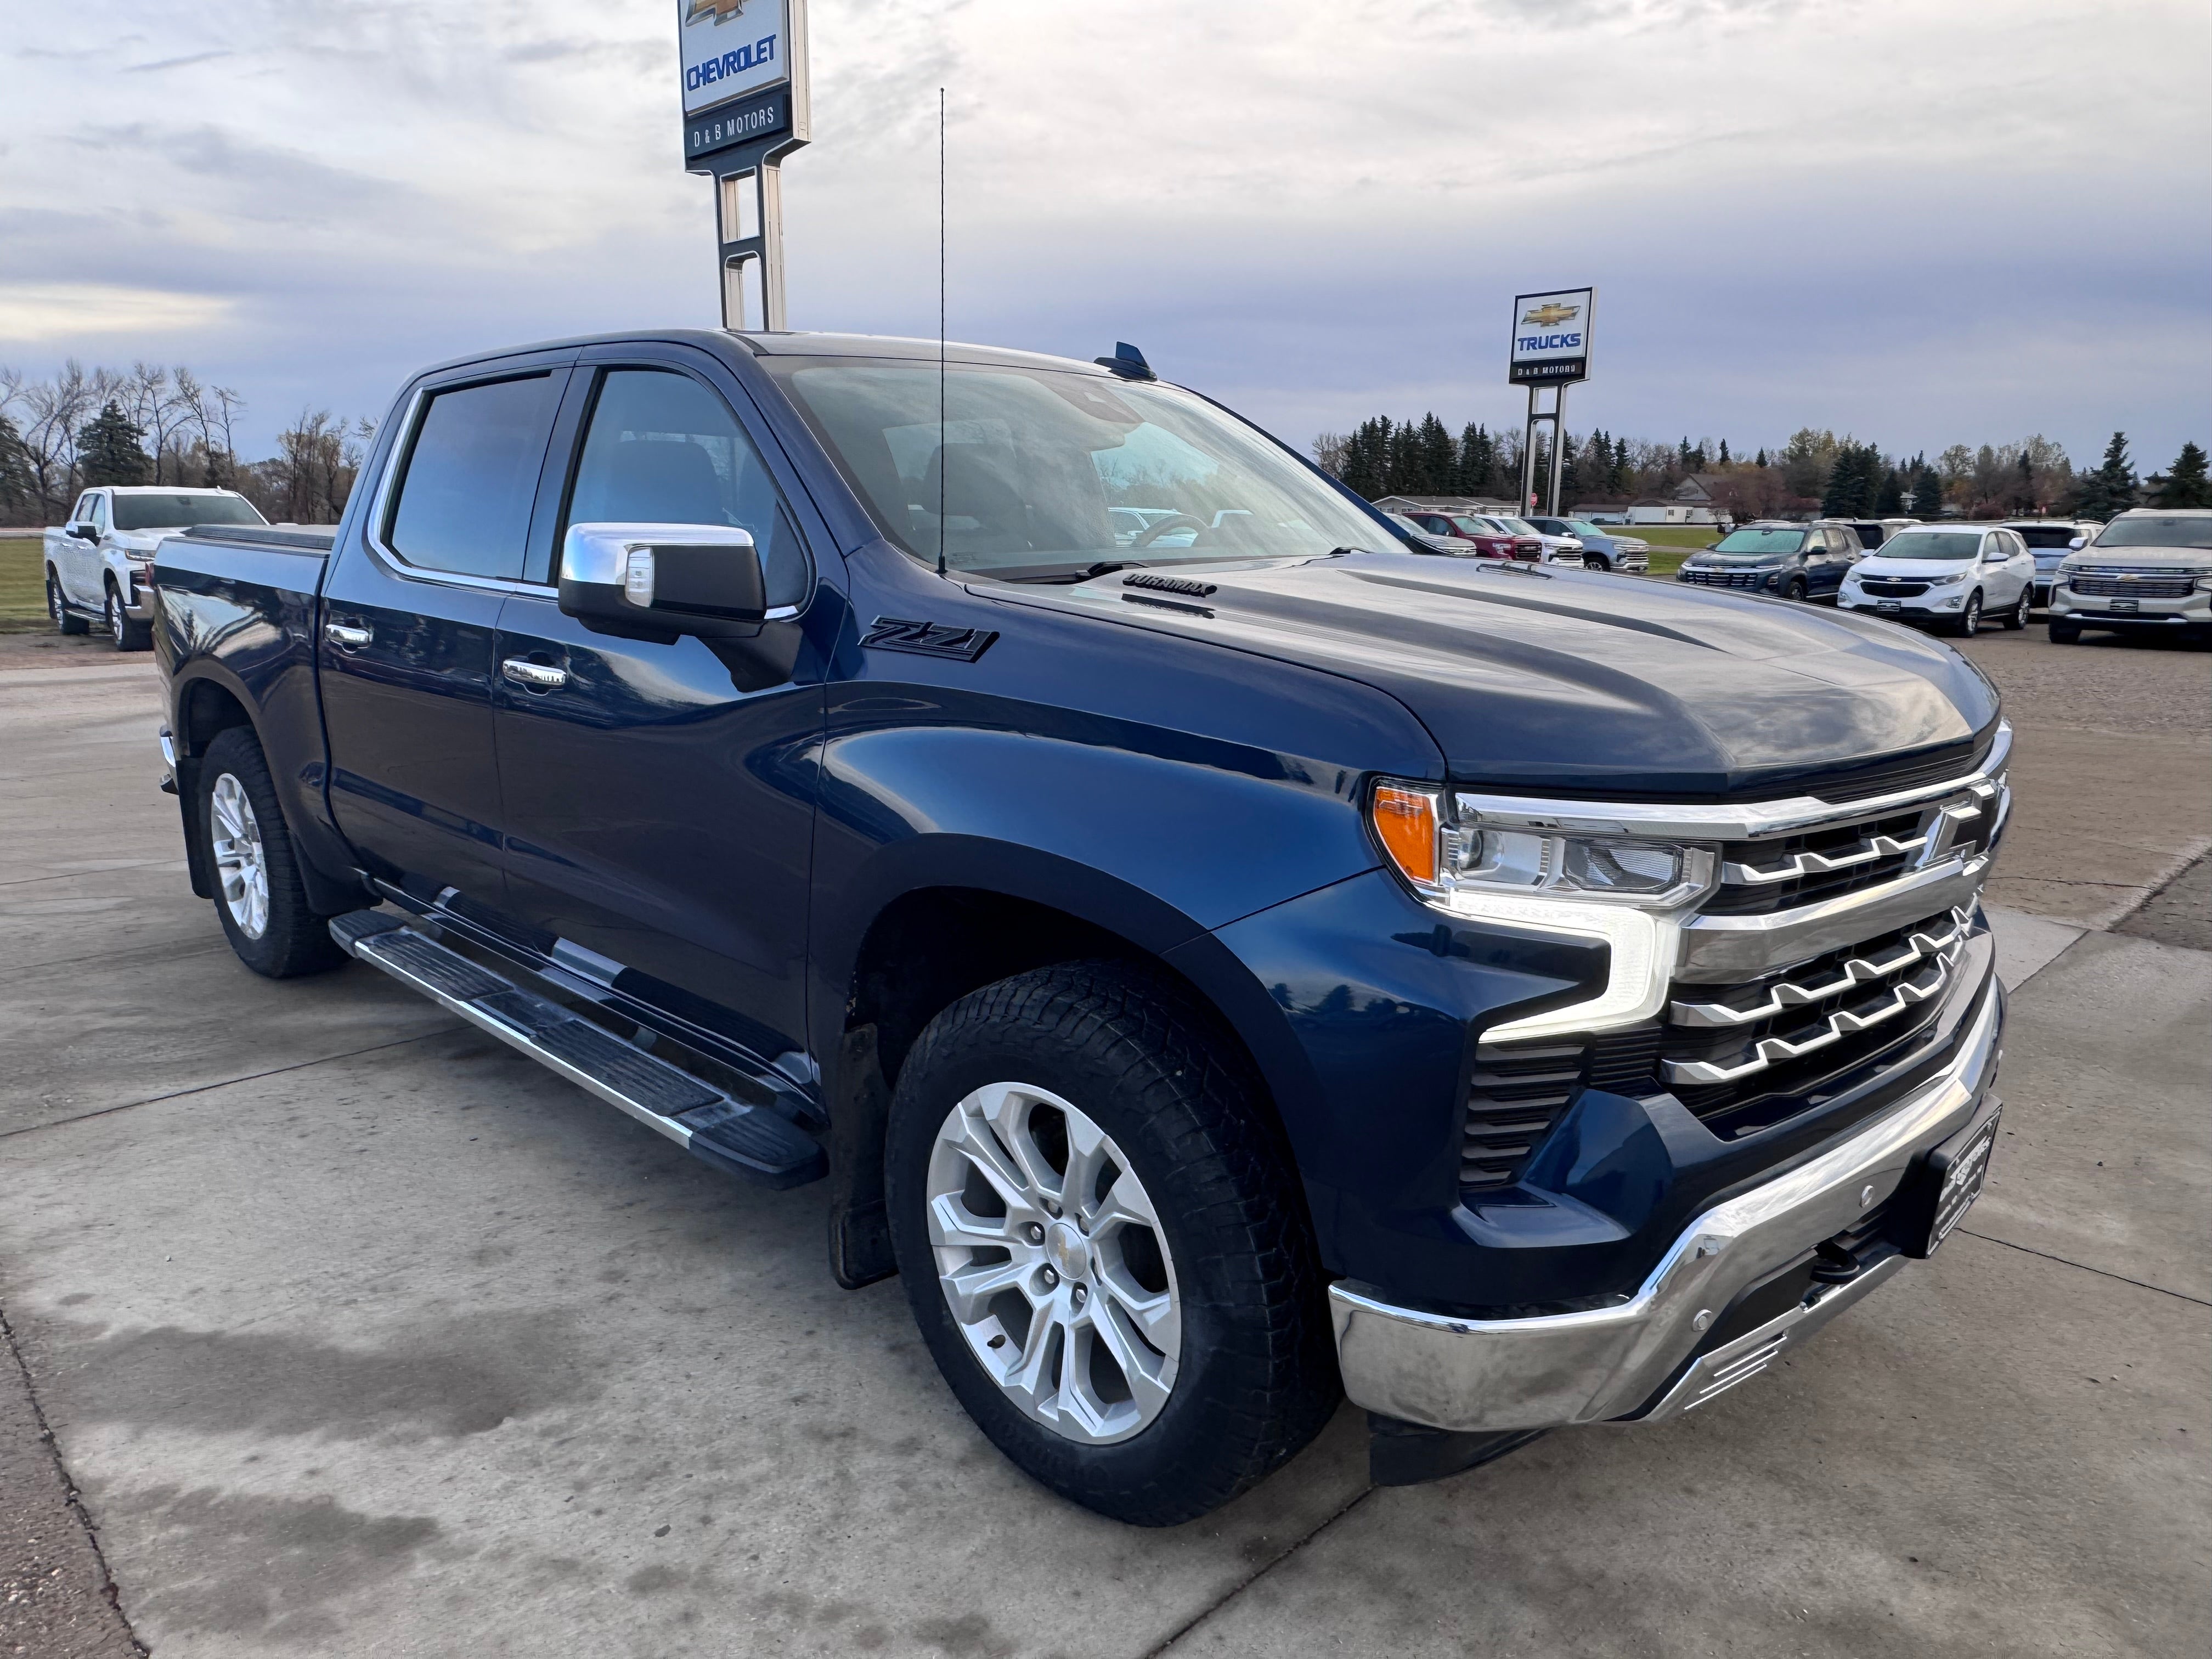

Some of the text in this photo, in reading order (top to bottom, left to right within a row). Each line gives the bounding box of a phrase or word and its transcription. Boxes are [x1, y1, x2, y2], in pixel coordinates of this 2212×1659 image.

[686, 34, 776, 91] CHEVROLET
[694, 106, 774, 147] D & B MOTORS
[1517, 333, 1581, 351] TRUCKS
[1542, 364, 1576, 374] MOTORS
[857, 614, 1000, 663] Z71
